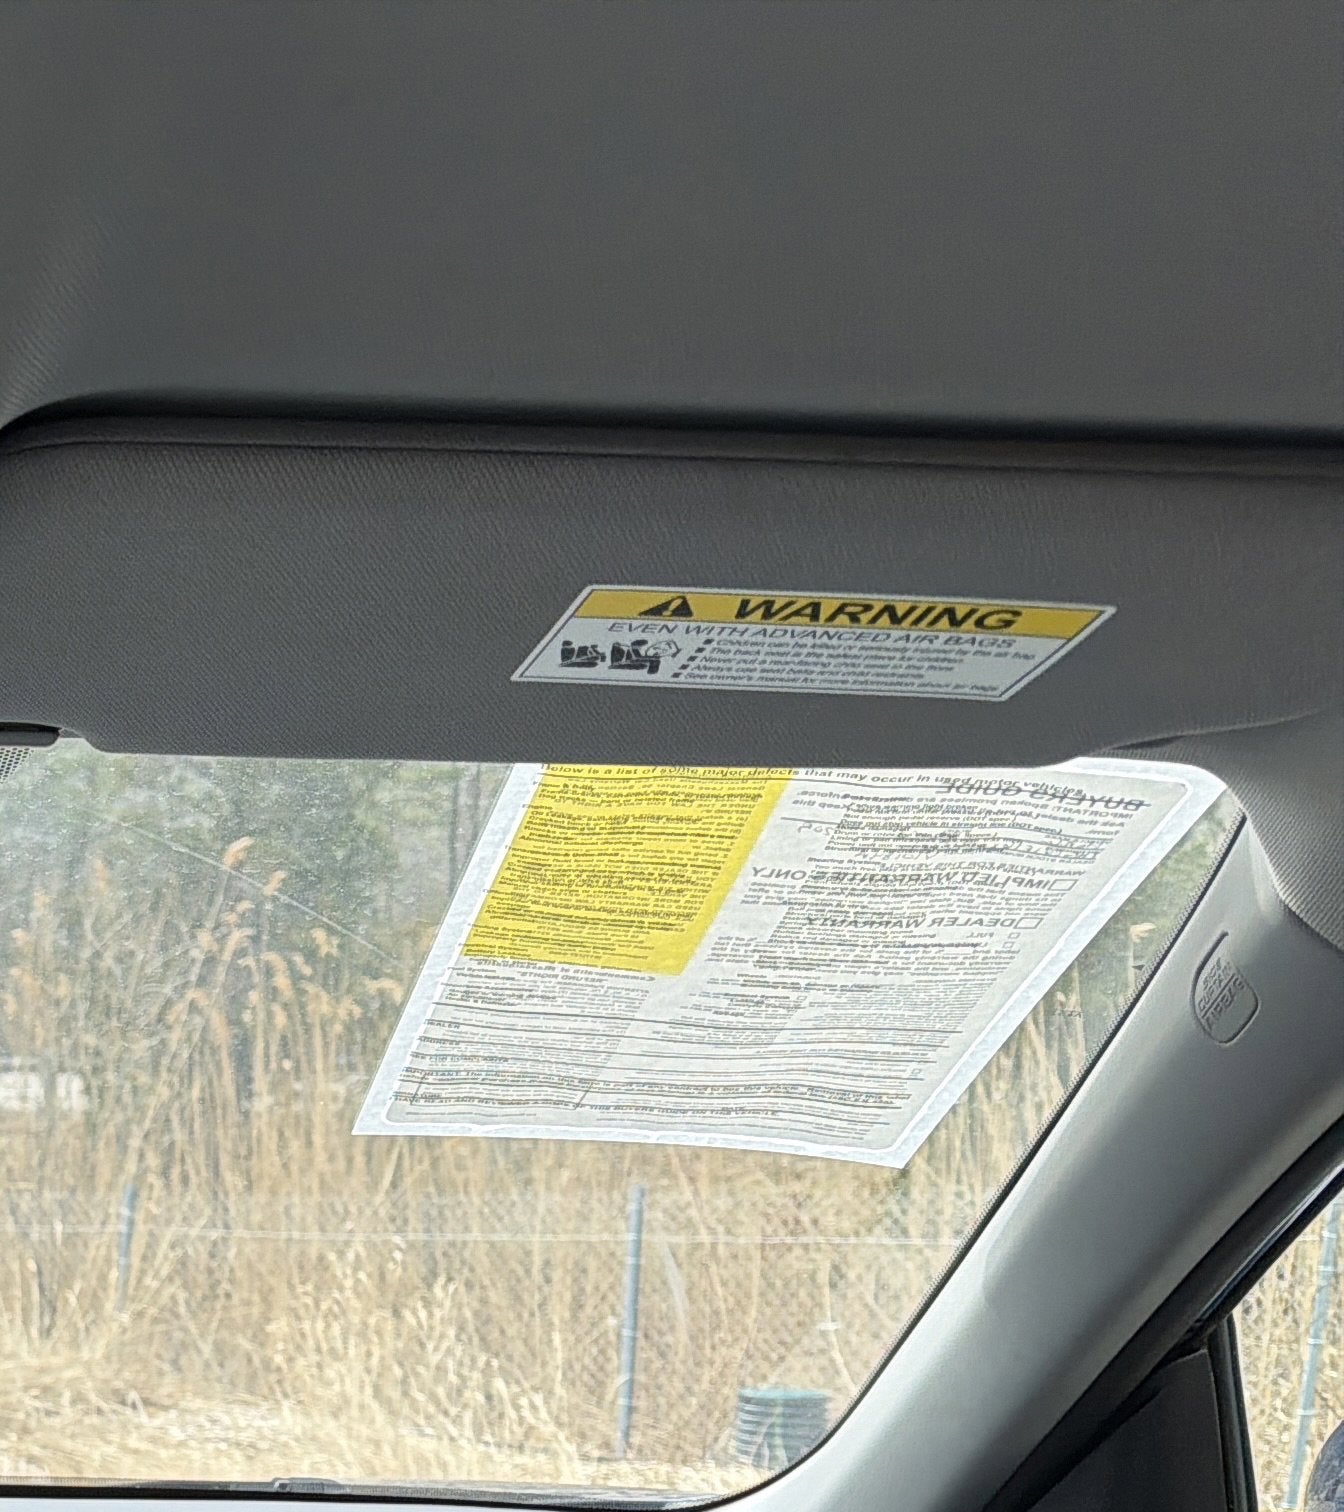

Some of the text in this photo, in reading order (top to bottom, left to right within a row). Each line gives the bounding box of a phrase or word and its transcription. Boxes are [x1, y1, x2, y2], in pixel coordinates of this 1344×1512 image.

[724, 597, 1031, 631] WARNING
[604, 621, 1020, 648] EVEN WITH ADVANCED AIR BAGS
[615, 766, 638, 776] list
[803, 769, 835, 779] that
[836, 771, 868, 782] may
[870, 773, 915, 784] occur
[917, 774, 931, 783] in
